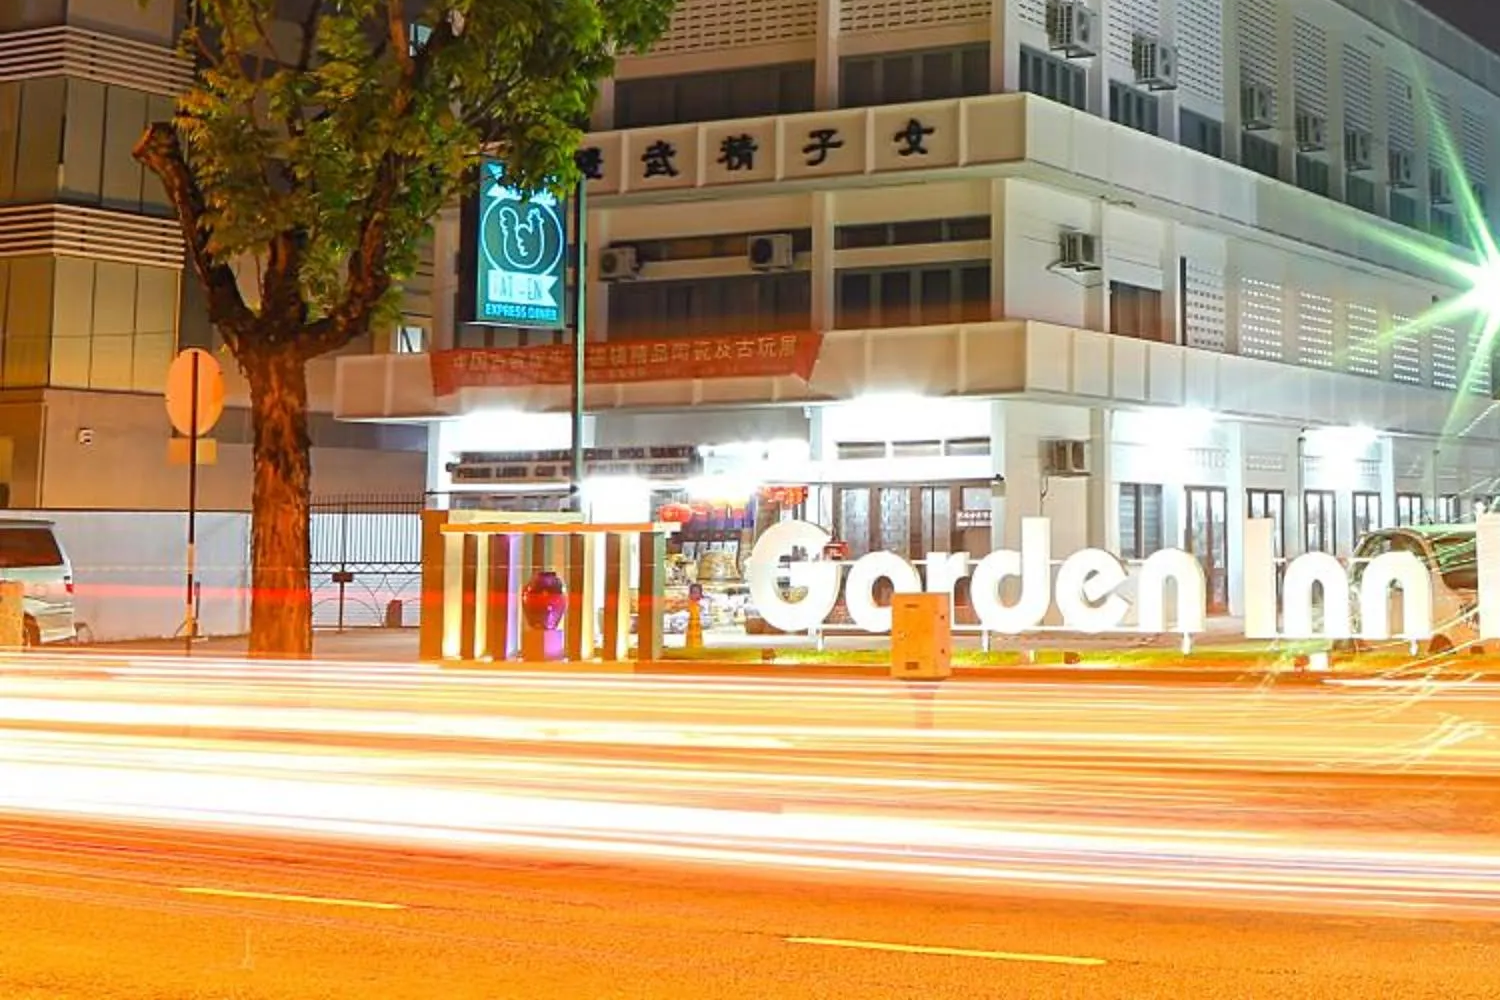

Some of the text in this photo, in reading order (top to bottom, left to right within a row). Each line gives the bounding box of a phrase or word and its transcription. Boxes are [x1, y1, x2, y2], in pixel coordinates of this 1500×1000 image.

[485, 303, 527, 318] EXPRESS
[748, 516, 1207, 637] Garden
[1245, 515, 1434, 640] Inn
